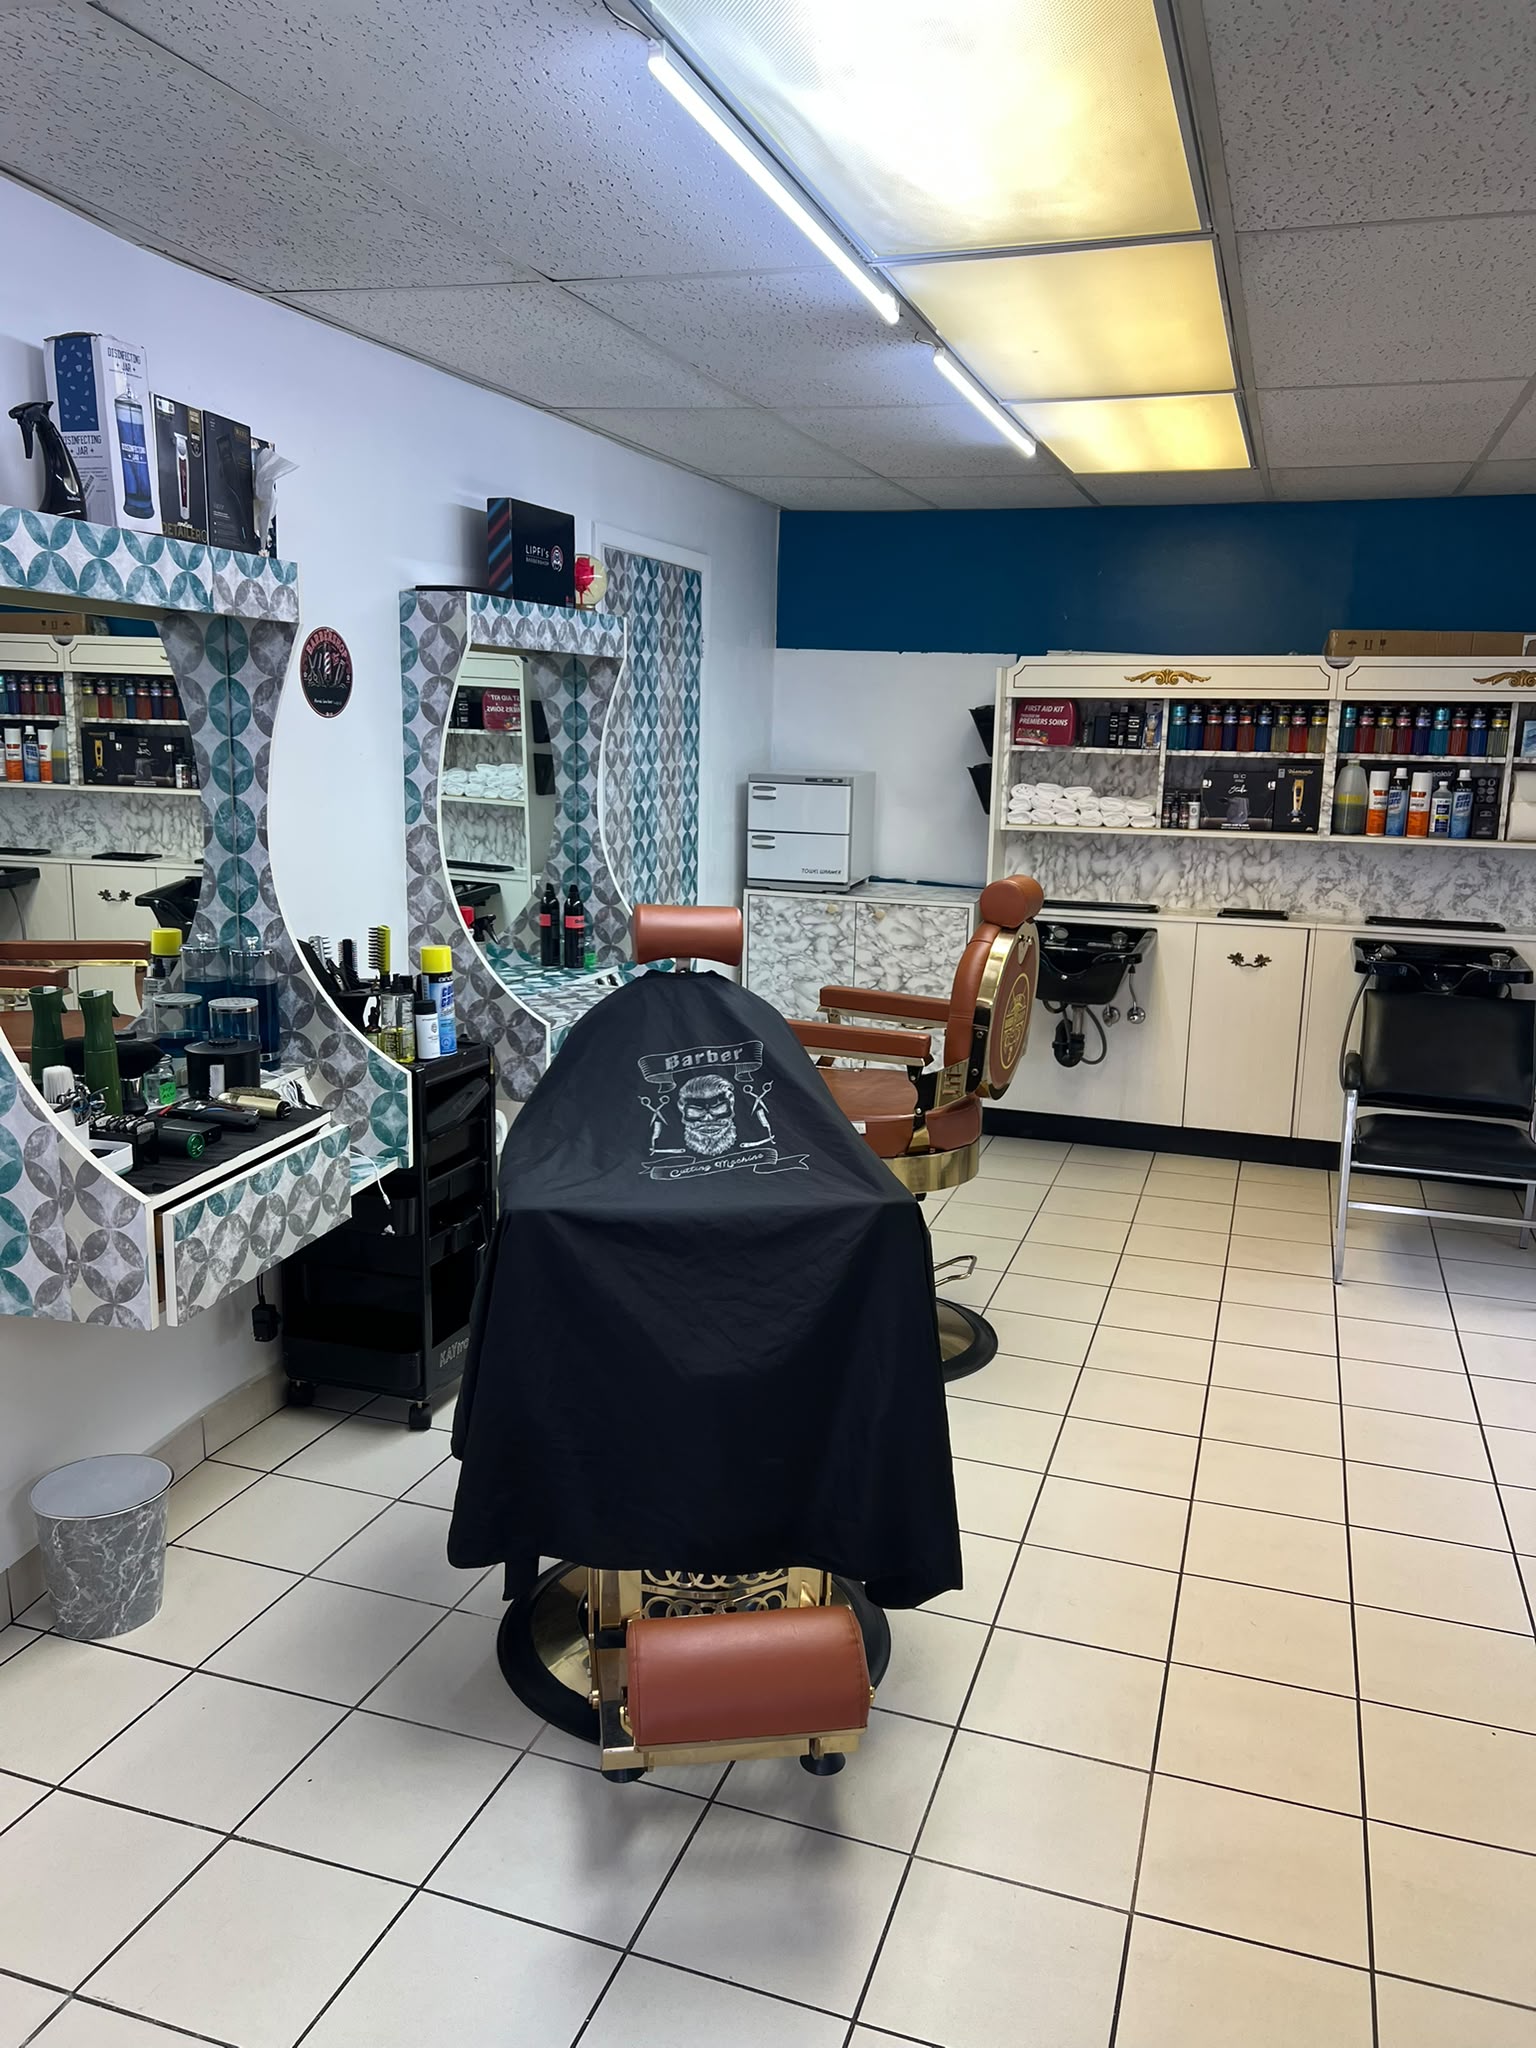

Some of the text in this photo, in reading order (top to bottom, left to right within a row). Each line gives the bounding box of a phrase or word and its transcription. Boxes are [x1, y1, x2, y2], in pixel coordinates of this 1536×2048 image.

[107, 347, 141, 365] DISINFECTING
[76, 446, 88, 455] JAR
[306, 630, 347, 657] BARBERSHOP
[1053, 705, 1064, 713] KIT
[1019, 717, 1068, 726] PREMIERS SOINS
[665, 1047, 743, 1071] Barber
[669, 1152, 765, 1178] Cutting Machine
